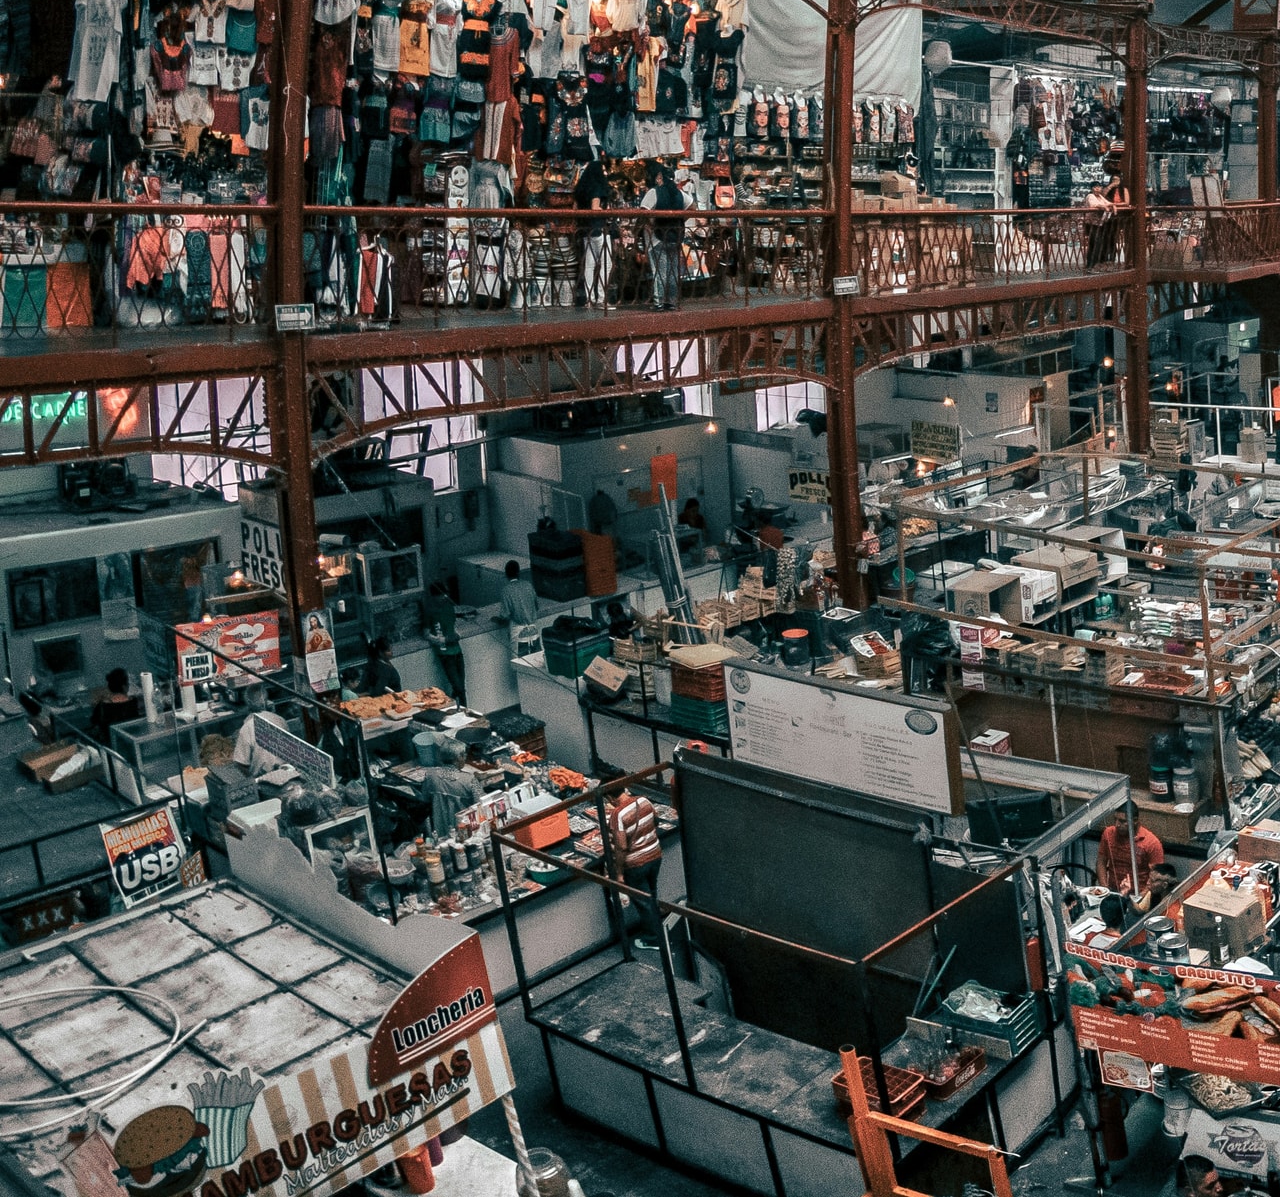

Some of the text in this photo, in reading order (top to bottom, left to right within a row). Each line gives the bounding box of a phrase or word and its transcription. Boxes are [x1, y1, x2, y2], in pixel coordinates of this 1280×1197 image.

[185, 655, 210, 667] PIERNA
[104, 811, 169, 848] MEMORIAS
[1176, 965, 1257, 988] BAGUETTE
[391, 985, 487, 1054] Lonchería
[283, 1114, 401, 1195] Malteadas
[1213, 1135, 1268, 1155] Tortas
